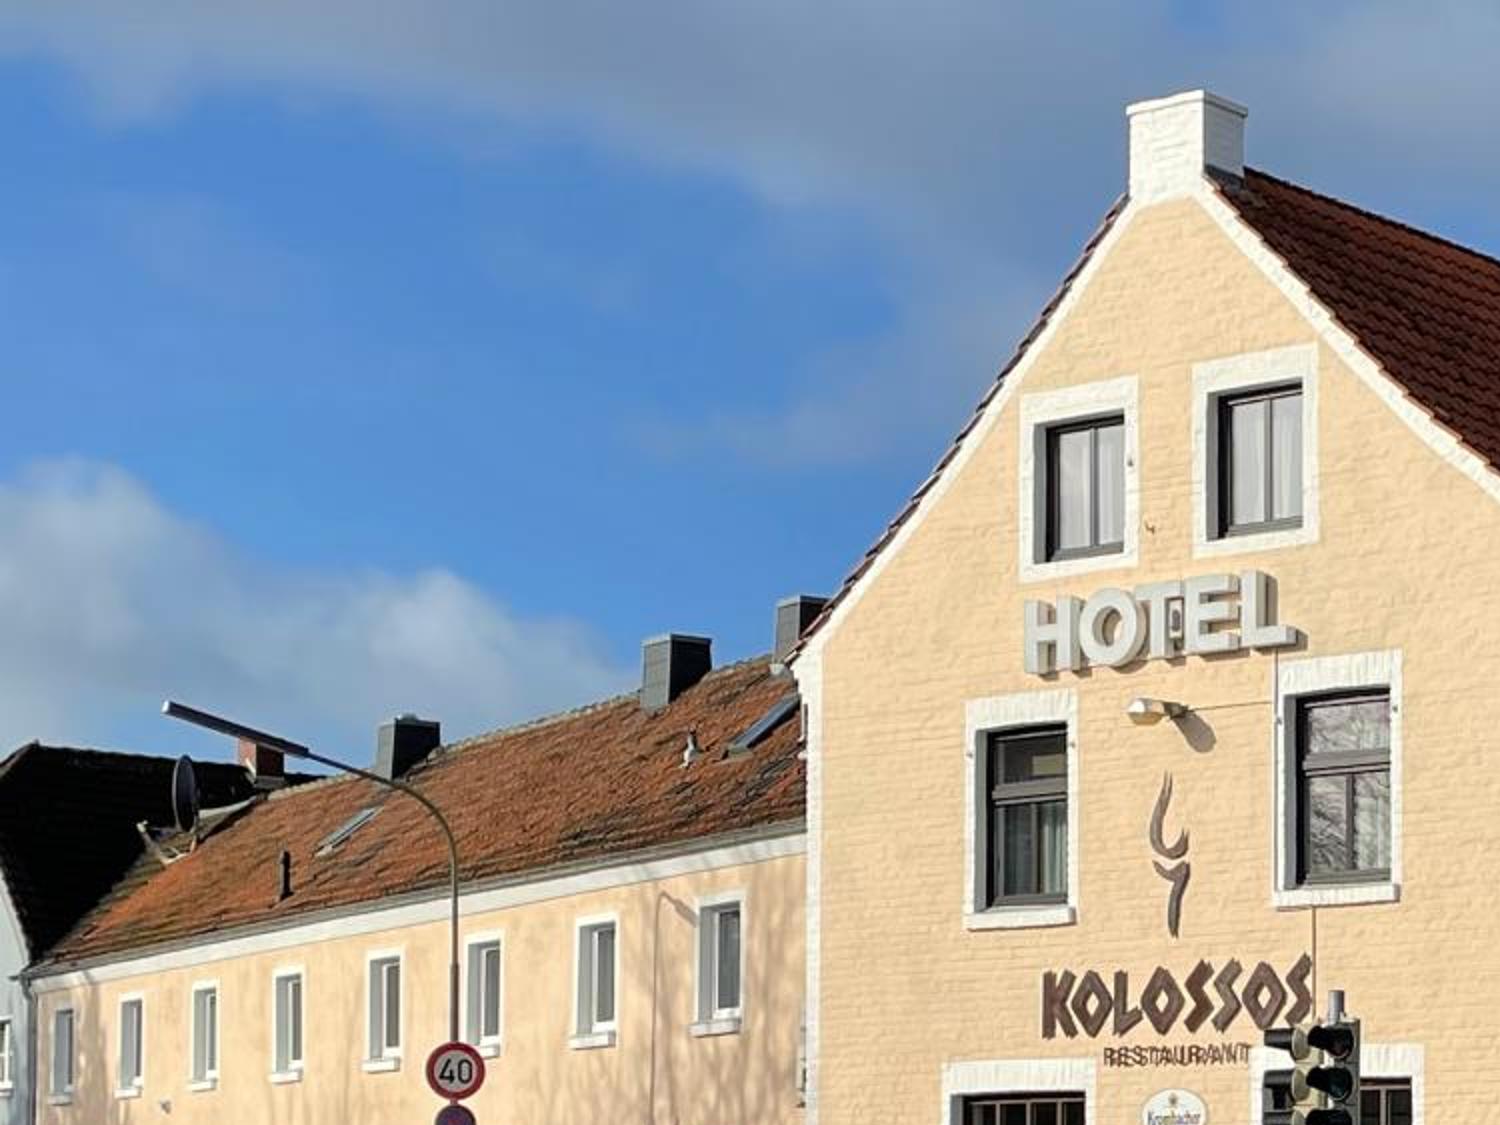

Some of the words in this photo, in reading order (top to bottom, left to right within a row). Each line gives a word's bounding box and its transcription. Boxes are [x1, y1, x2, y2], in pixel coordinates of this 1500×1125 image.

[1023, 569, 1298, 674] HOTEL
[1042, 952, 1313, 1039] KOLOSSOS
[439, 1058, 473, 1084] 40
[1103, 1042, 1249, 1068] RESTAURANT
